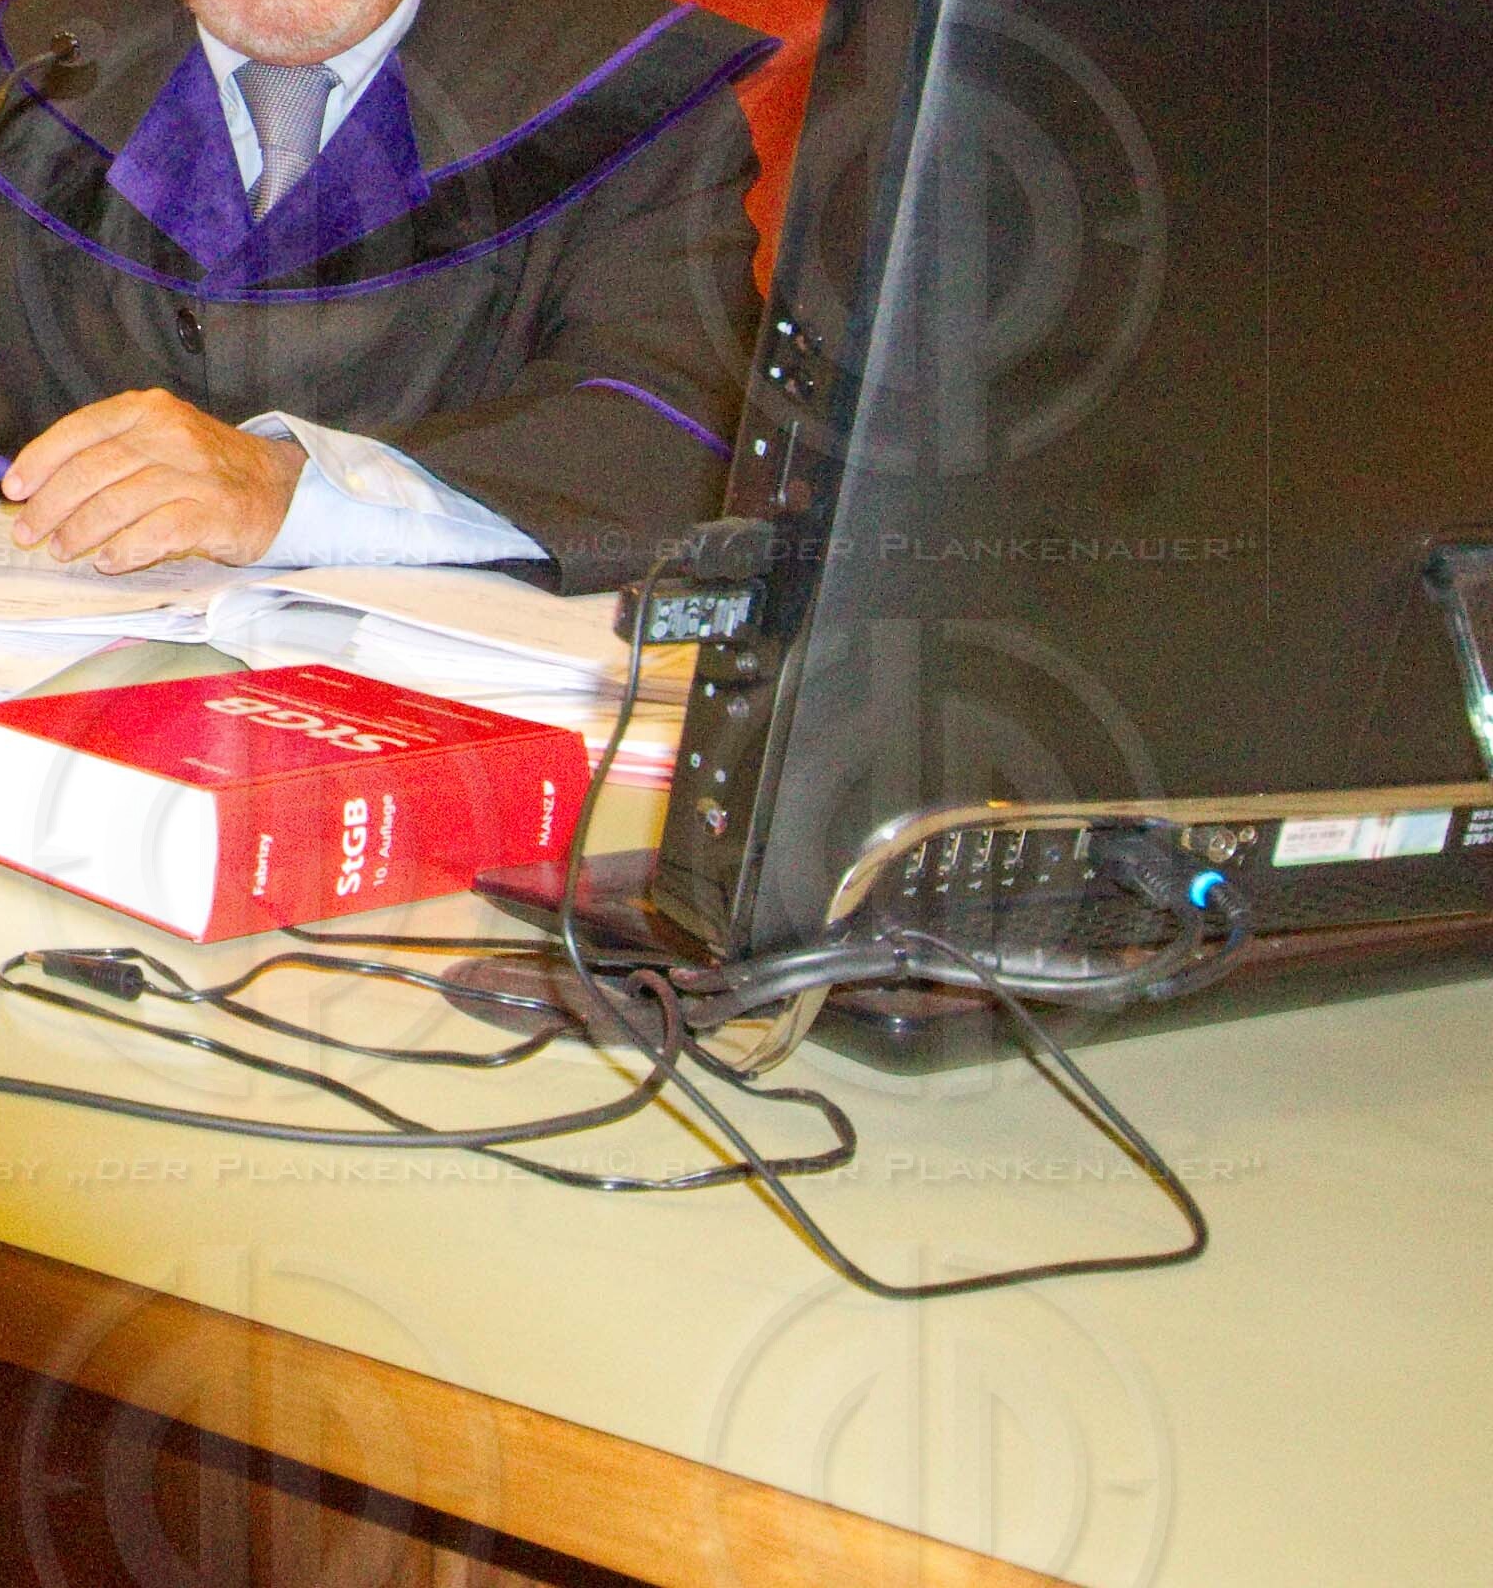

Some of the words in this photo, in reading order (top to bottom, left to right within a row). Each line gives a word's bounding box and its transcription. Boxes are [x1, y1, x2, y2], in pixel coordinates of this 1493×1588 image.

[336, 796, 370, 898] StGB
[379, 792, 398, 859] Auflage
[538, 796, 557, 847] MANZ
[252, 832, 274, 897] Fabrizy
[372, 861, 390, 887] 10.
